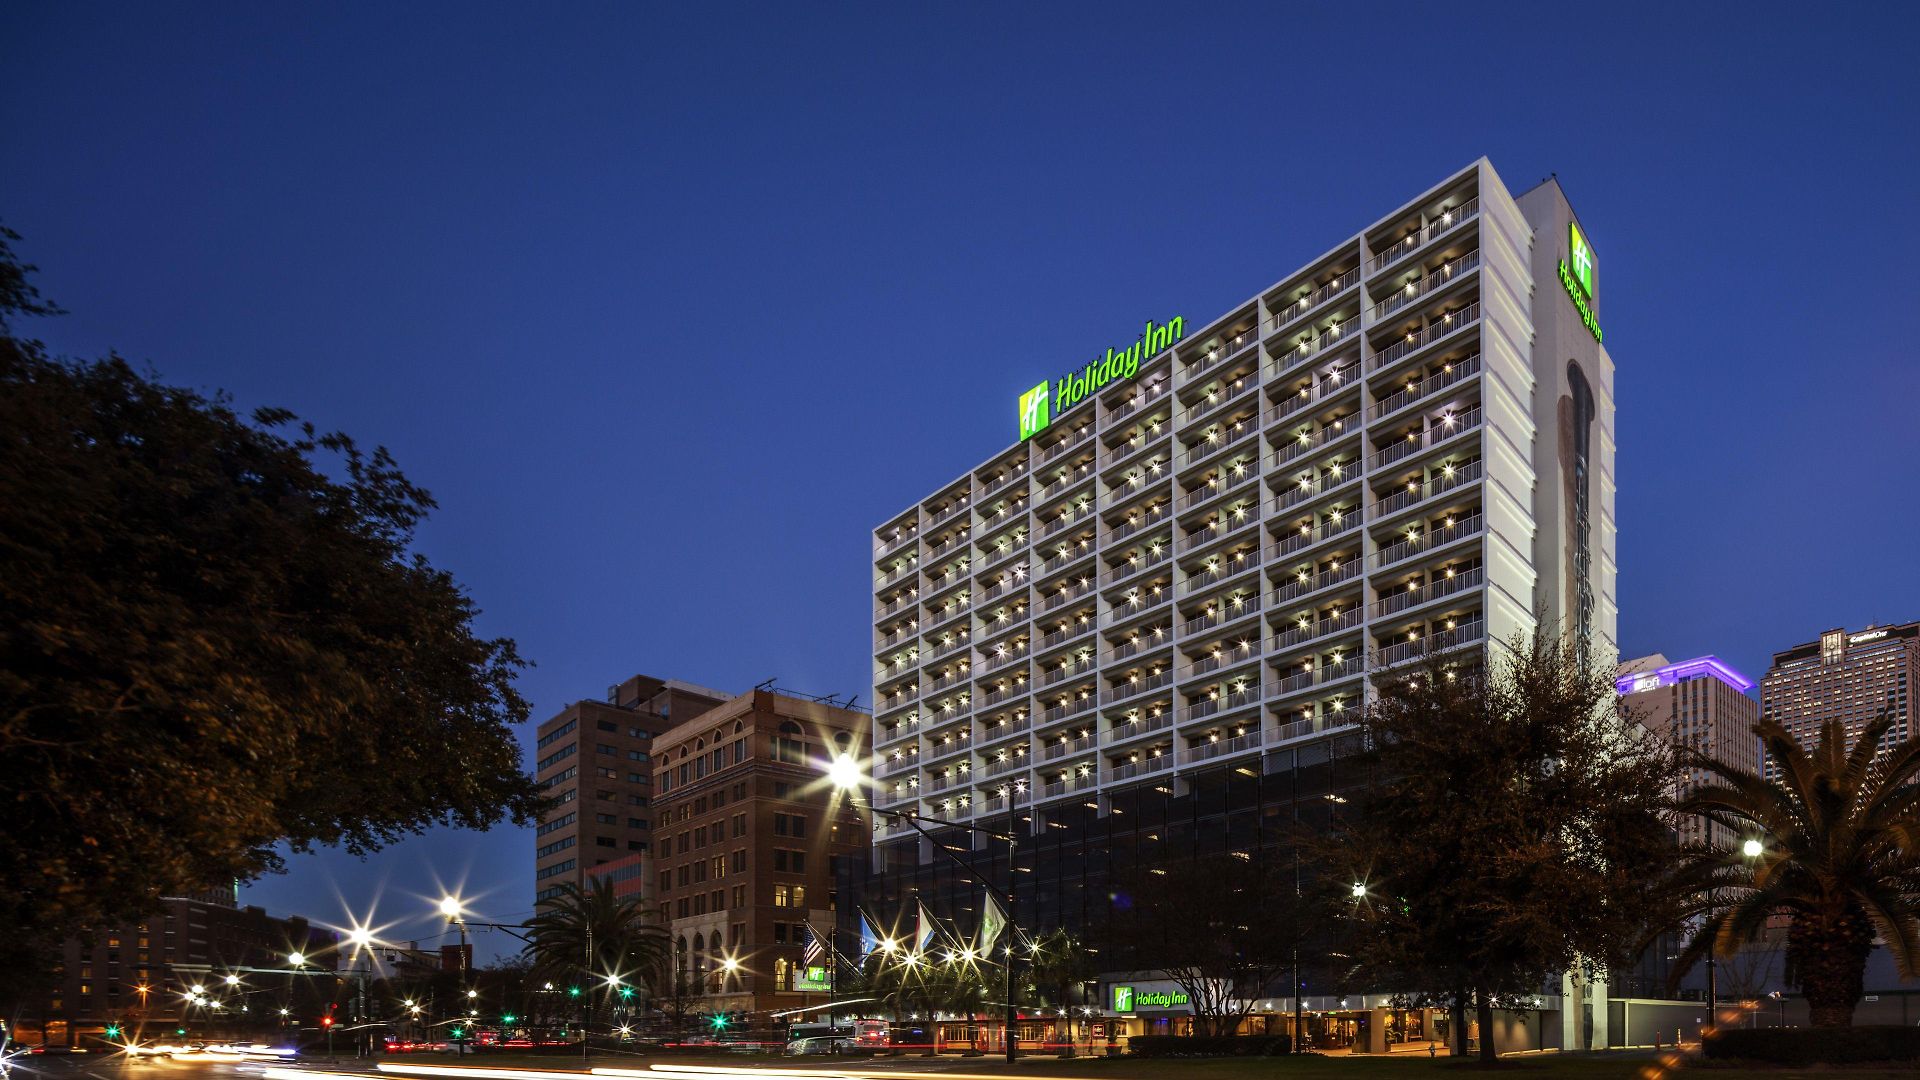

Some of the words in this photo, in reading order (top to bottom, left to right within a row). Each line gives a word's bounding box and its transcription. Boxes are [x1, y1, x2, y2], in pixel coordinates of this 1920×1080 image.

[1558, 258, 1591, 325] Holiday
[1590, 311, 1603, 343] Inn
[1055, 341, 1142, 413] Holiday
[1144, 315, 1183, 359] Inn
[1136, 992, 1172, 1008] Holiday
[1171, 990, 1188, 1004] Inn
